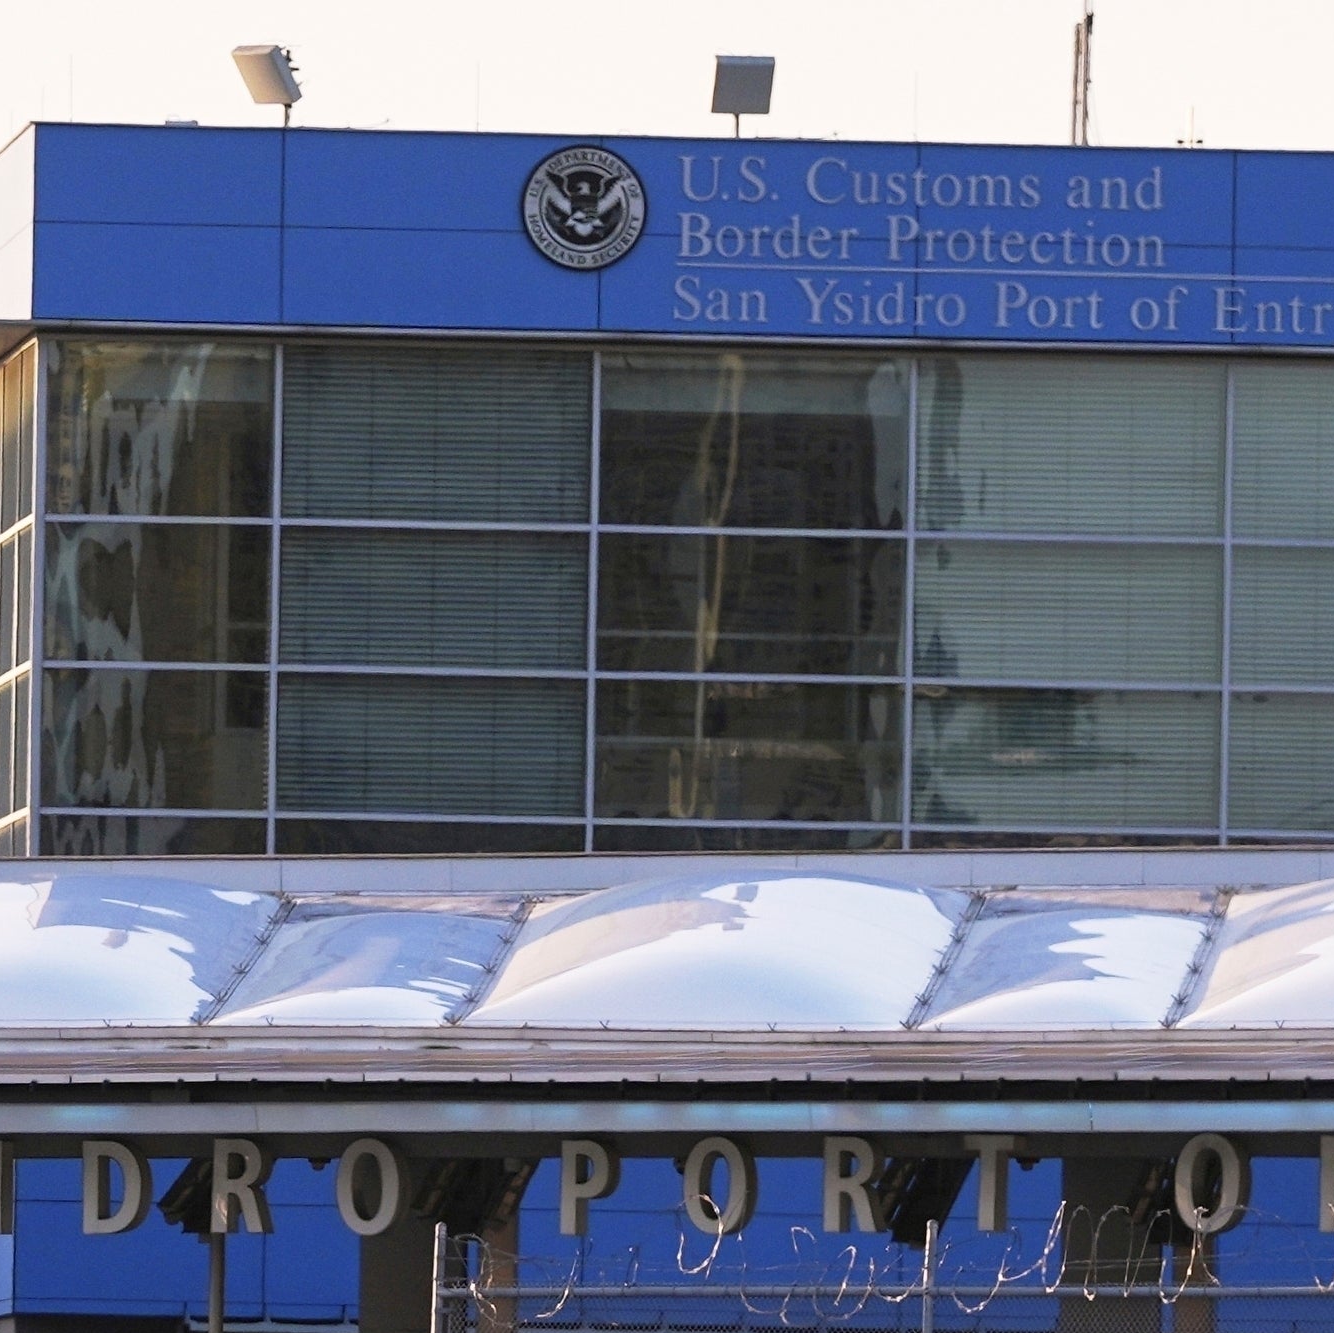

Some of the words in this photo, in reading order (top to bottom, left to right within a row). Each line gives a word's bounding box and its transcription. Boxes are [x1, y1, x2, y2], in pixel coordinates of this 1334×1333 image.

[679, 156, 779, 202] U.S.
[806, 156, 1042, 208] Customs
[1066, 166, 1164, 211] and
[677, 212, 860, 260] Border
[886, 214, 1167, 268] Protection
[673, 274, 768, 323] San
[796, 277, 967, 328] Ysidro
[995, 280, 1105, 331] Port
[1129, 285, 1189, 332] of
[560, 1134, 1017, 1236] PORT
